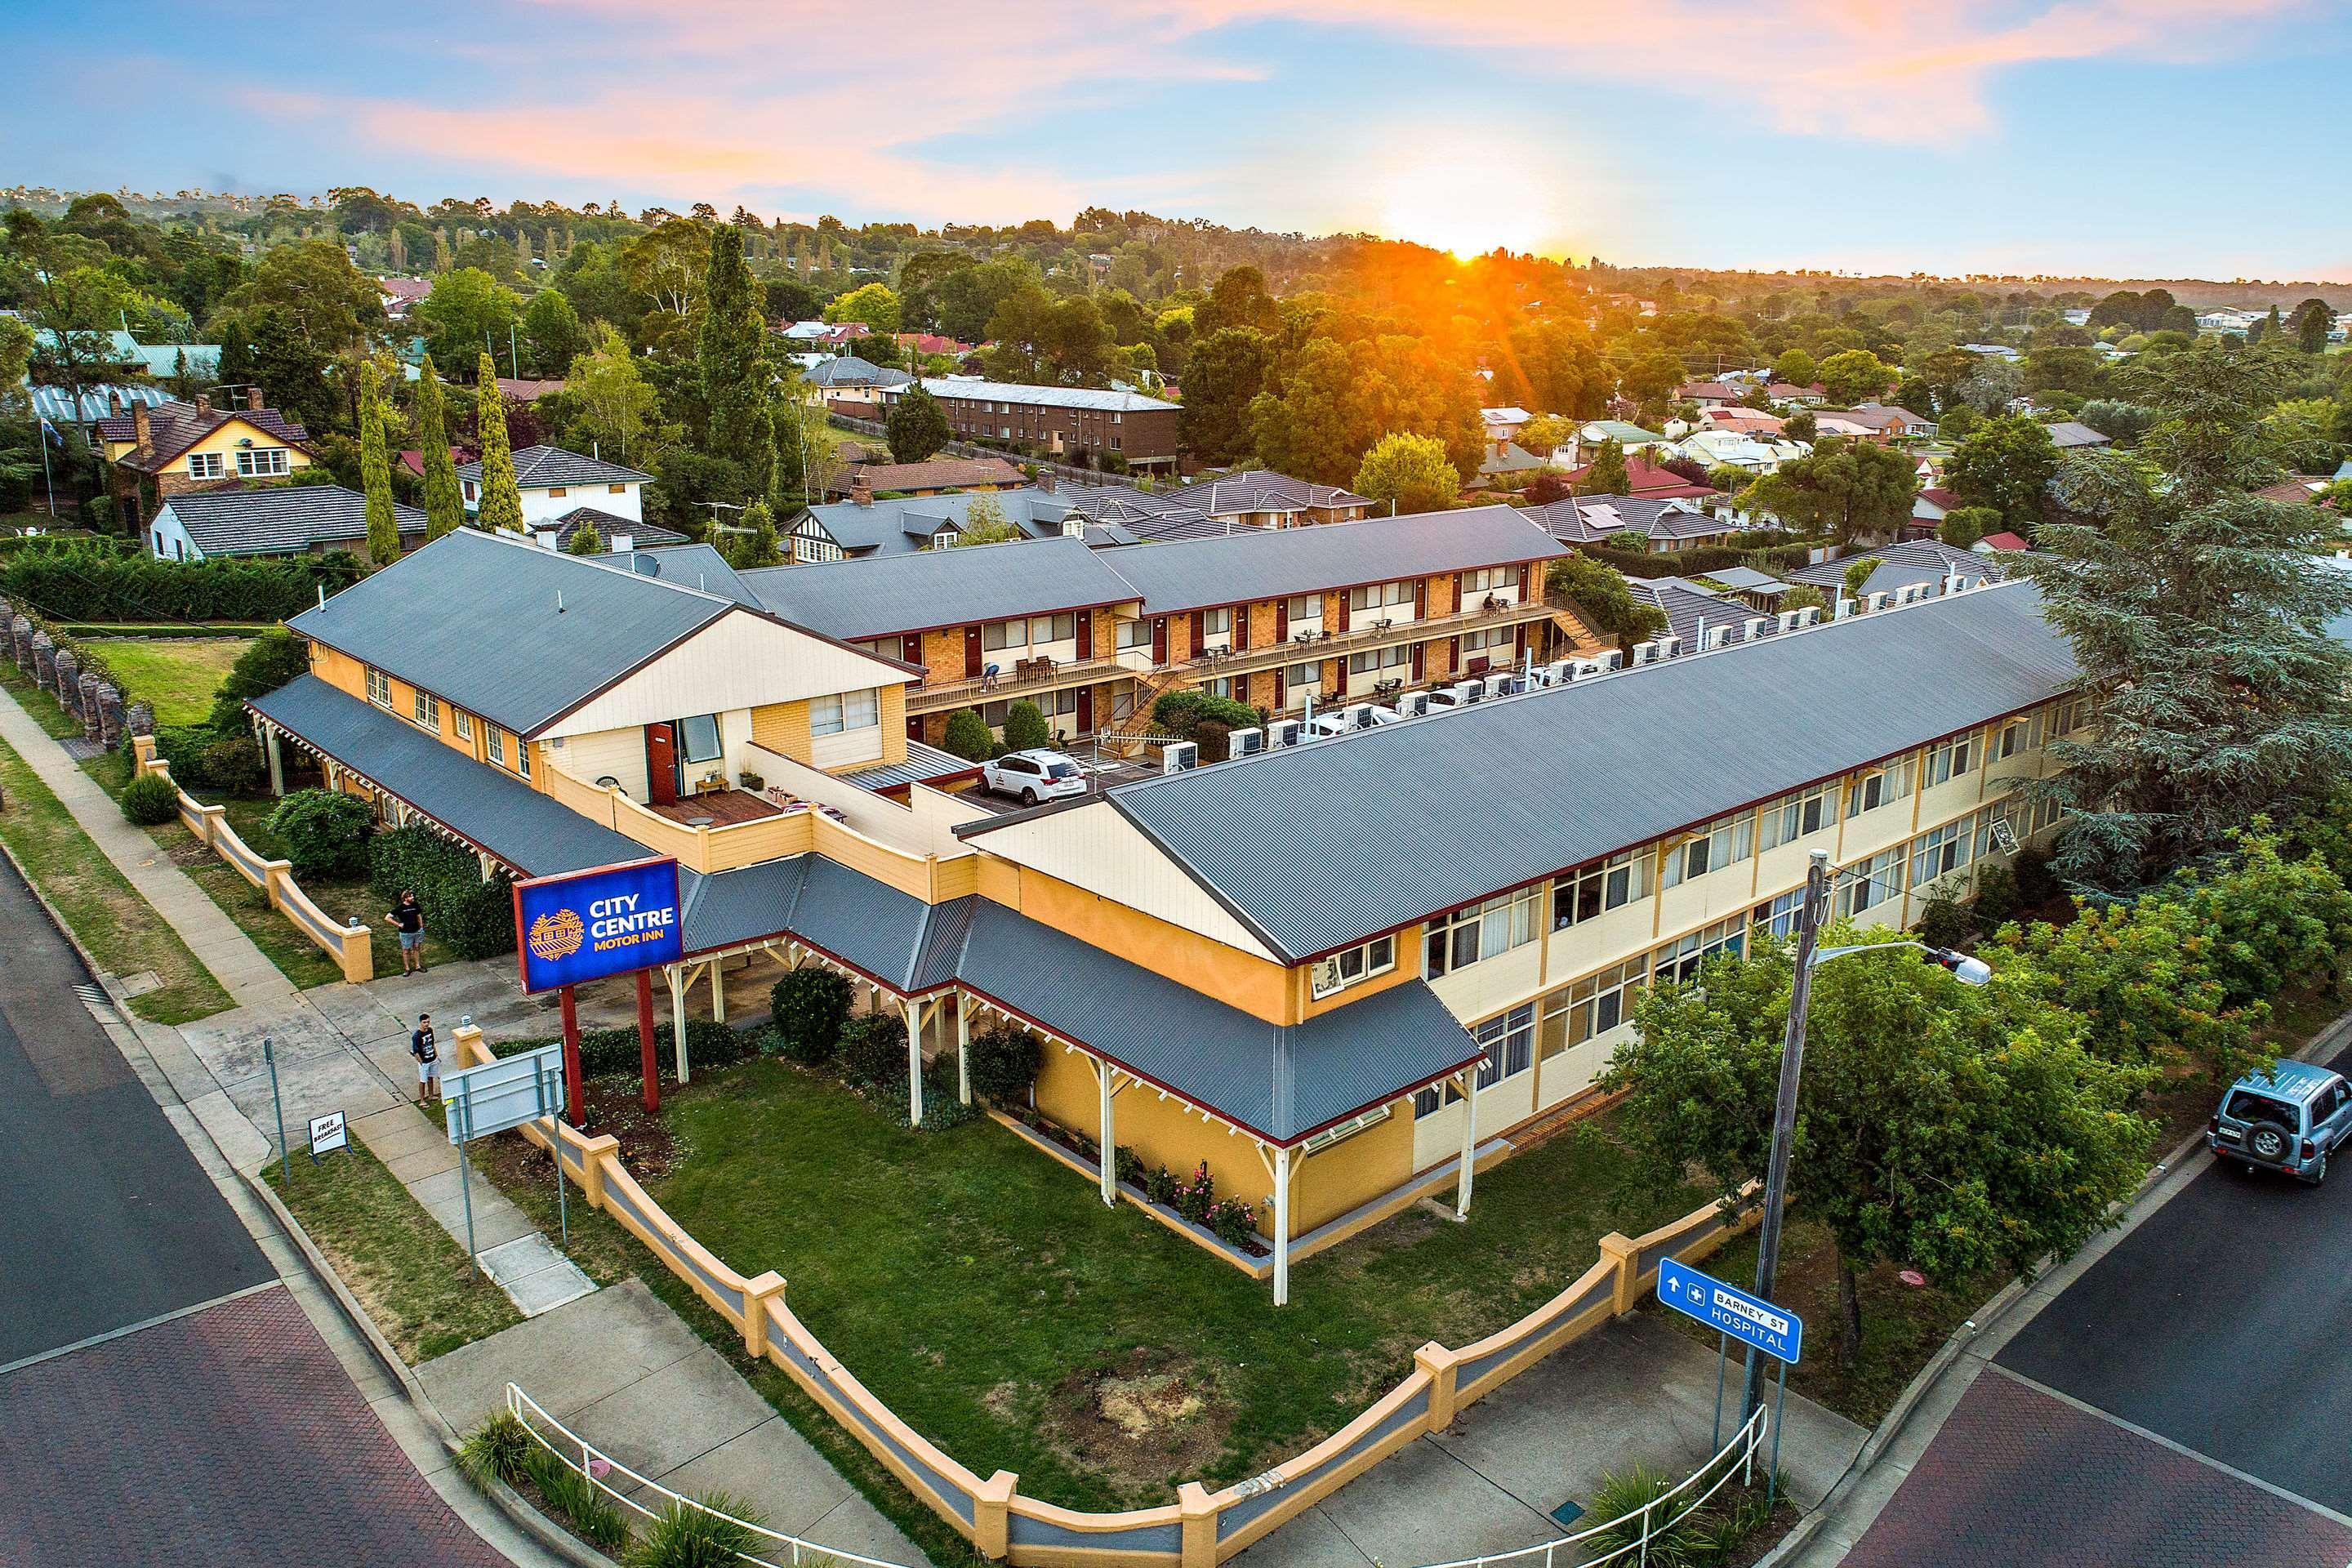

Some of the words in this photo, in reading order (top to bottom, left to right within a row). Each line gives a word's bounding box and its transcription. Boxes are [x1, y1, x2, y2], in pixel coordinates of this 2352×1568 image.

[590, 893, 639, 918] CITY
[591, 907, 674, 938] CENTRE
[595, 934, 639, 952] MOTOR
[641, 929, 664, 941] INN
[314, 1124, 342, 1143] BREAKFAST
[318, 1120, 334, 1132] FREE
[1717, 1294, 1764, 1321] BARNEY
[1770, 1318, 1785, 1331] ST
[1712, 1307, 1787, 1352] HOSPITAL
